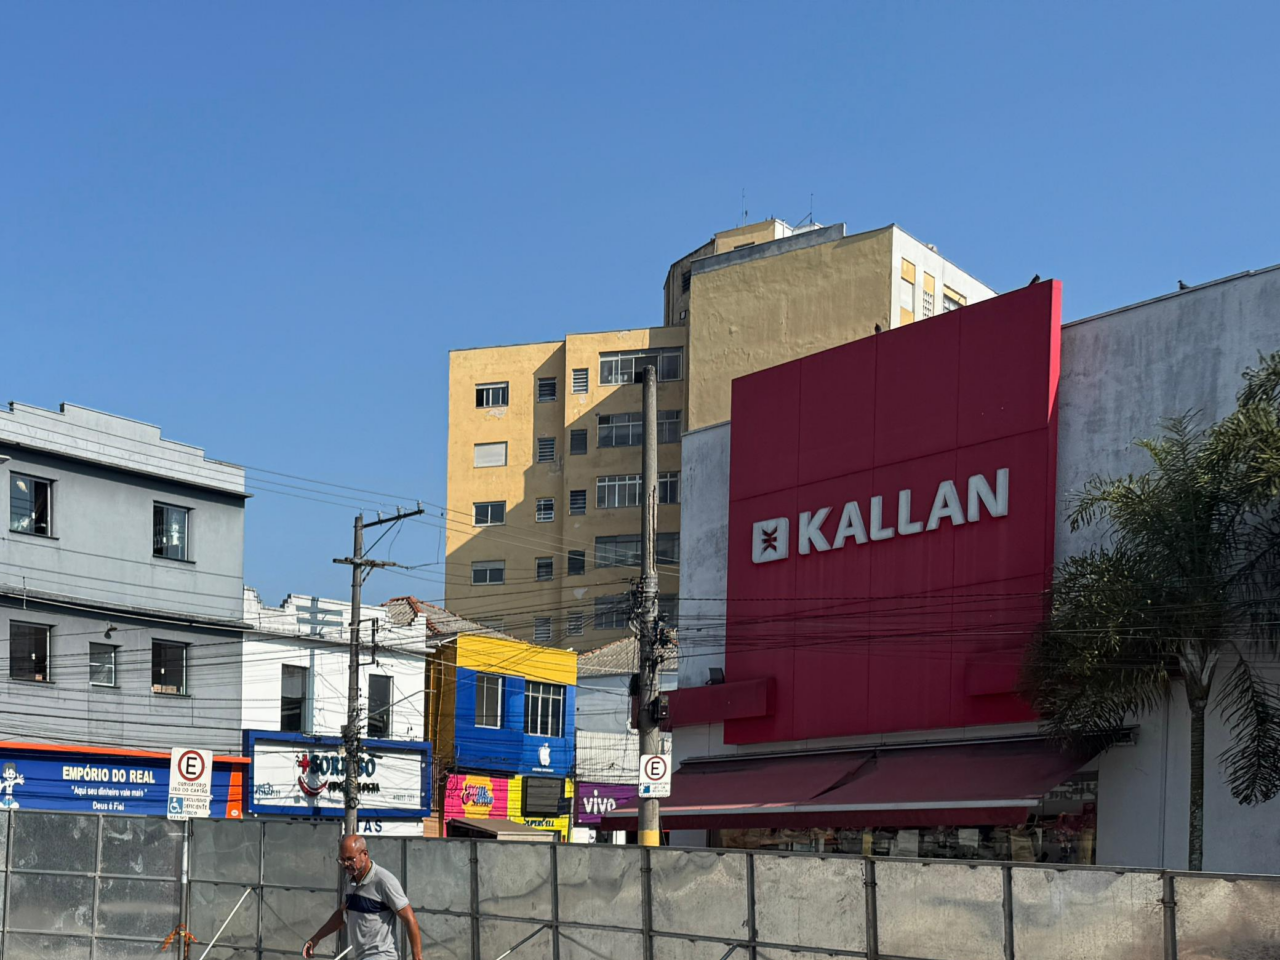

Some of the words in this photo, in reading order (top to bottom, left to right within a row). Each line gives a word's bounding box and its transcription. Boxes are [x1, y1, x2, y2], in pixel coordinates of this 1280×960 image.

[798, 468, 1010, 556] KALLAN
[63, 764, 109, 782] EMPÓRIO
[112, 769, 127, 783] DO
[130, 769, 156, 784] REAL
[186, 756, 198, 775] E
[651, 762, 660, 775] E
[98, 787, 119, 796] dinheiro
[120, 788, 131, 797] vale
[583, 789, 616, 814] vivo
[92, 801, 108, 810] Deus
[114, 802, 125, 811] Fiel
